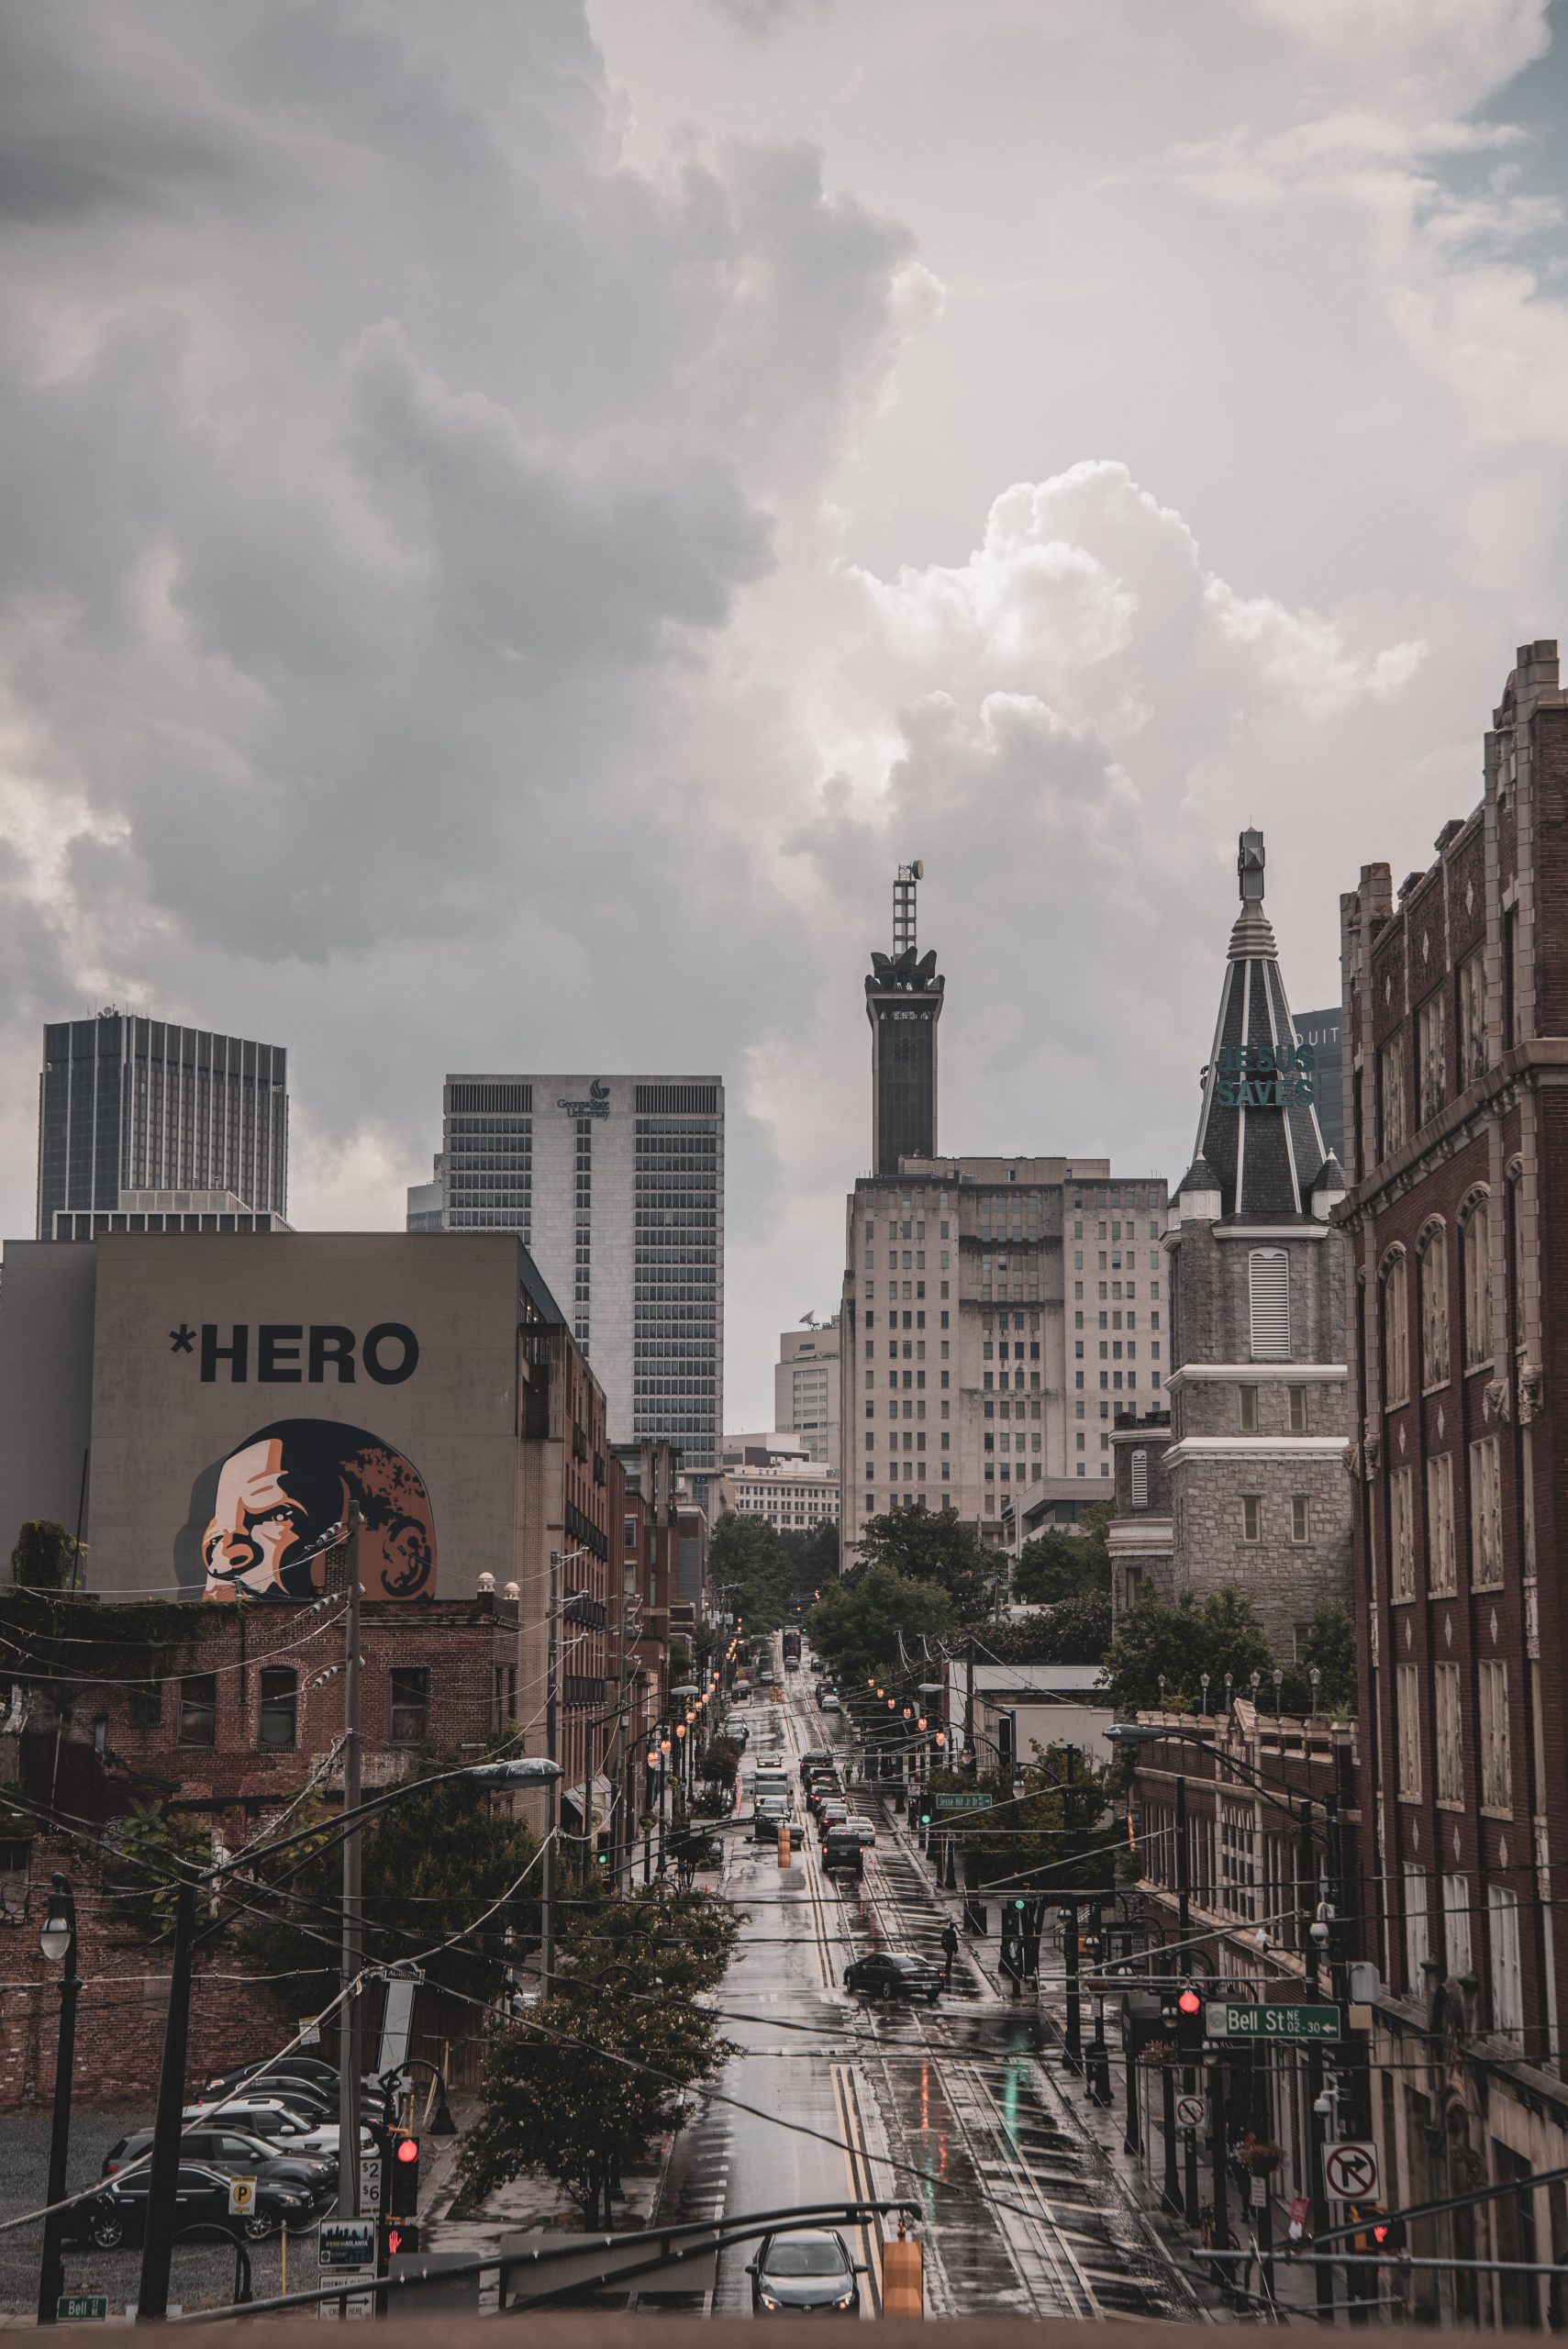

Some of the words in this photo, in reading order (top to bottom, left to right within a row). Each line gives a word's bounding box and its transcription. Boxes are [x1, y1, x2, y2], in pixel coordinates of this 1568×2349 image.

[1215, 1044, 1315, 1073] JESUS
[1216, 1079, 1315, 1107] SAVES
[557, 1098, 590, 1109] Georgia
[590, 1098, 610, 1108] State
[567, 1108, 610, 1121] University
[940, 1798, 954, 1806] Jesse
[1228, 2009, 1258, 2031] Bell
[1265, 2009, 1285, 2032] St
[1286, 2009, 1300, 2021] NE
[1286, 2022, 1321, 2033] 02-30
[362, 2162, 379, 2178] $2
[239, 2186, 248, 2202] P
[362, 2185, 380, 2200] $6
[68, 2300, 87, 2316] Bell
